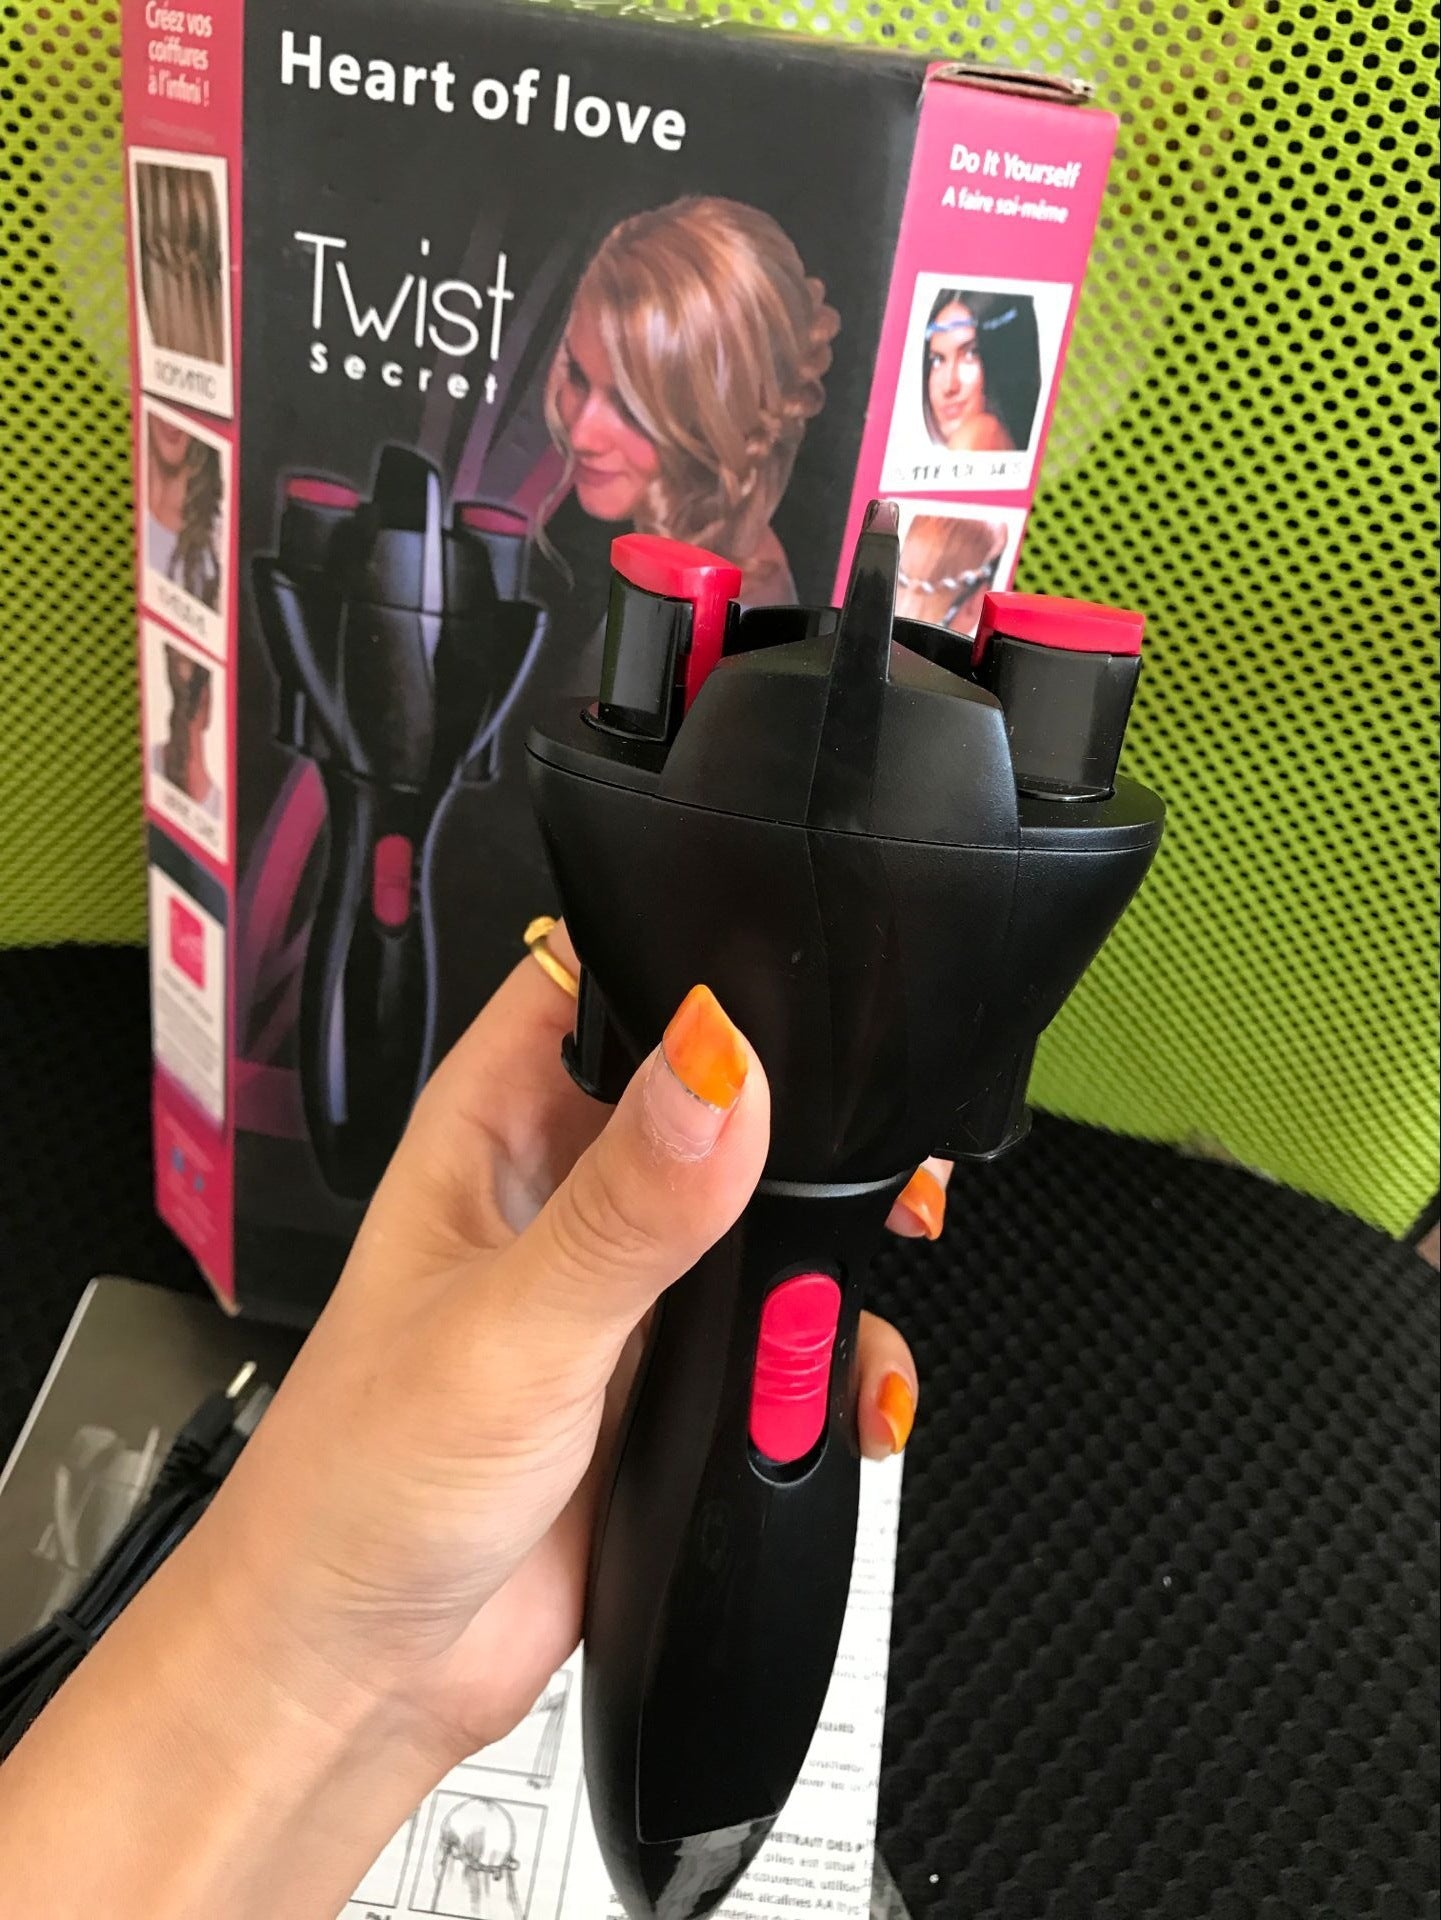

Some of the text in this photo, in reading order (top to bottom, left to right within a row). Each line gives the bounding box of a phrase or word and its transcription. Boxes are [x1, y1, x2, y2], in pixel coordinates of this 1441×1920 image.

[186, 12, 212, 38] vos
[148, 35, 208, 70] coiffures
[281, 31, 687, 151] Heart of love
[950, 143, 1082, 190] Do It Yourself
[941, 185, 956, 208] A
[958, 186, 994, 214] faire
[295, 231, 514, 361] Twist
[309, 342, 499, 404] secret
